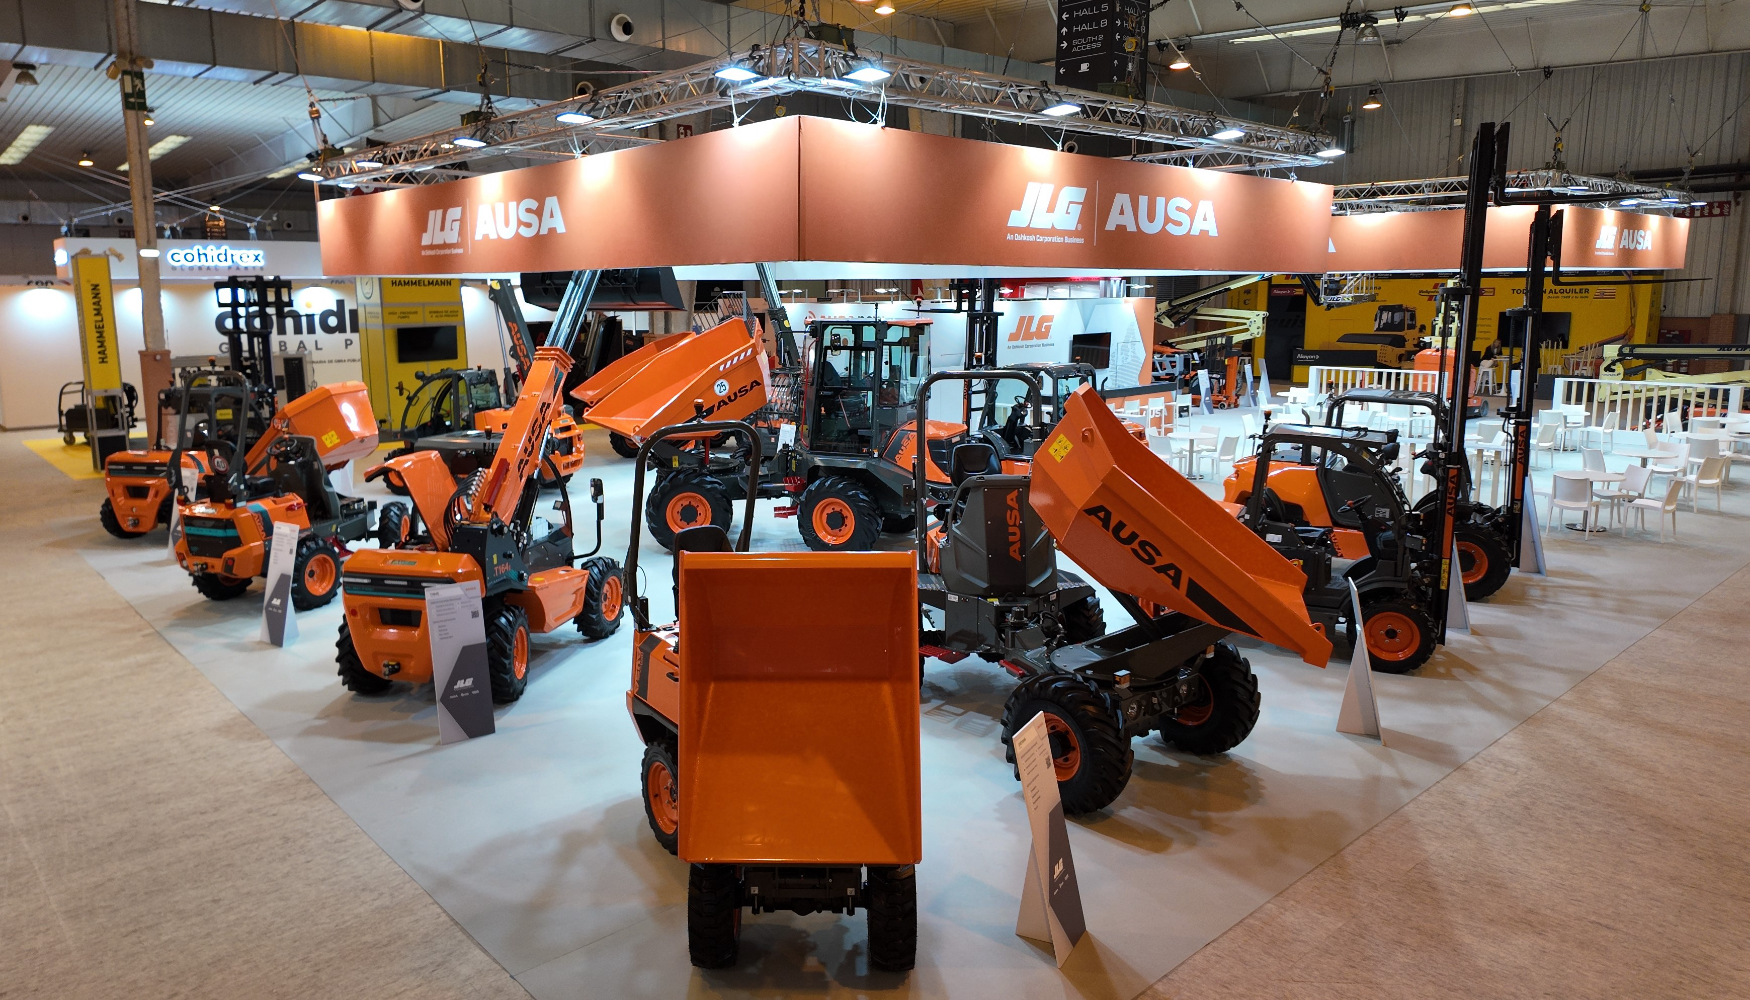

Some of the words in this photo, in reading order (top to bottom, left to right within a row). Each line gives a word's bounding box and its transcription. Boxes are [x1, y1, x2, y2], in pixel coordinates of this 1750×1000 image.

[1073, 6, 1100, 18] HALL
[1101, 3, 1109, 12] 5
[1073, 22, 1099, 32] HALL
[1100, 19, 1108, 27] 8
[1072, 36, 1098, 45] SOUTH
[1072, 42, 1102, 52] ACCESS
[421, 207, 462, 246] JLG
[475, 196, 566, 240] AUSA
[1007, 181, 1087, 231] JLG
[1105, 193, 1218, 237] AUSA
[1620, 228, 1652, 250] AUSA
[170, 247, 263, 263] cohidrex
[391, 279, 452, 287] HAMMELMANN
[91, 283, 109, 365] HAMMELMANN
[1007, 314, 1055, 342] JLG
[508, 321, 531, 371] AUSA
[716, 381, 728, 394] 25
[716, 379, 762, 411] AUSA
[517, 401, 552, 481] AUSA
[1517, 428, 1527, 465] AUSA
[1447, 474, 1458, 518] AUSA
[1008, 488, 1023, 562] AUSA
[1082, 504, 1184, 590] AUSA
[453, 677, 474, 689] JLG
[1053, 857, 1064, 880] JLG
